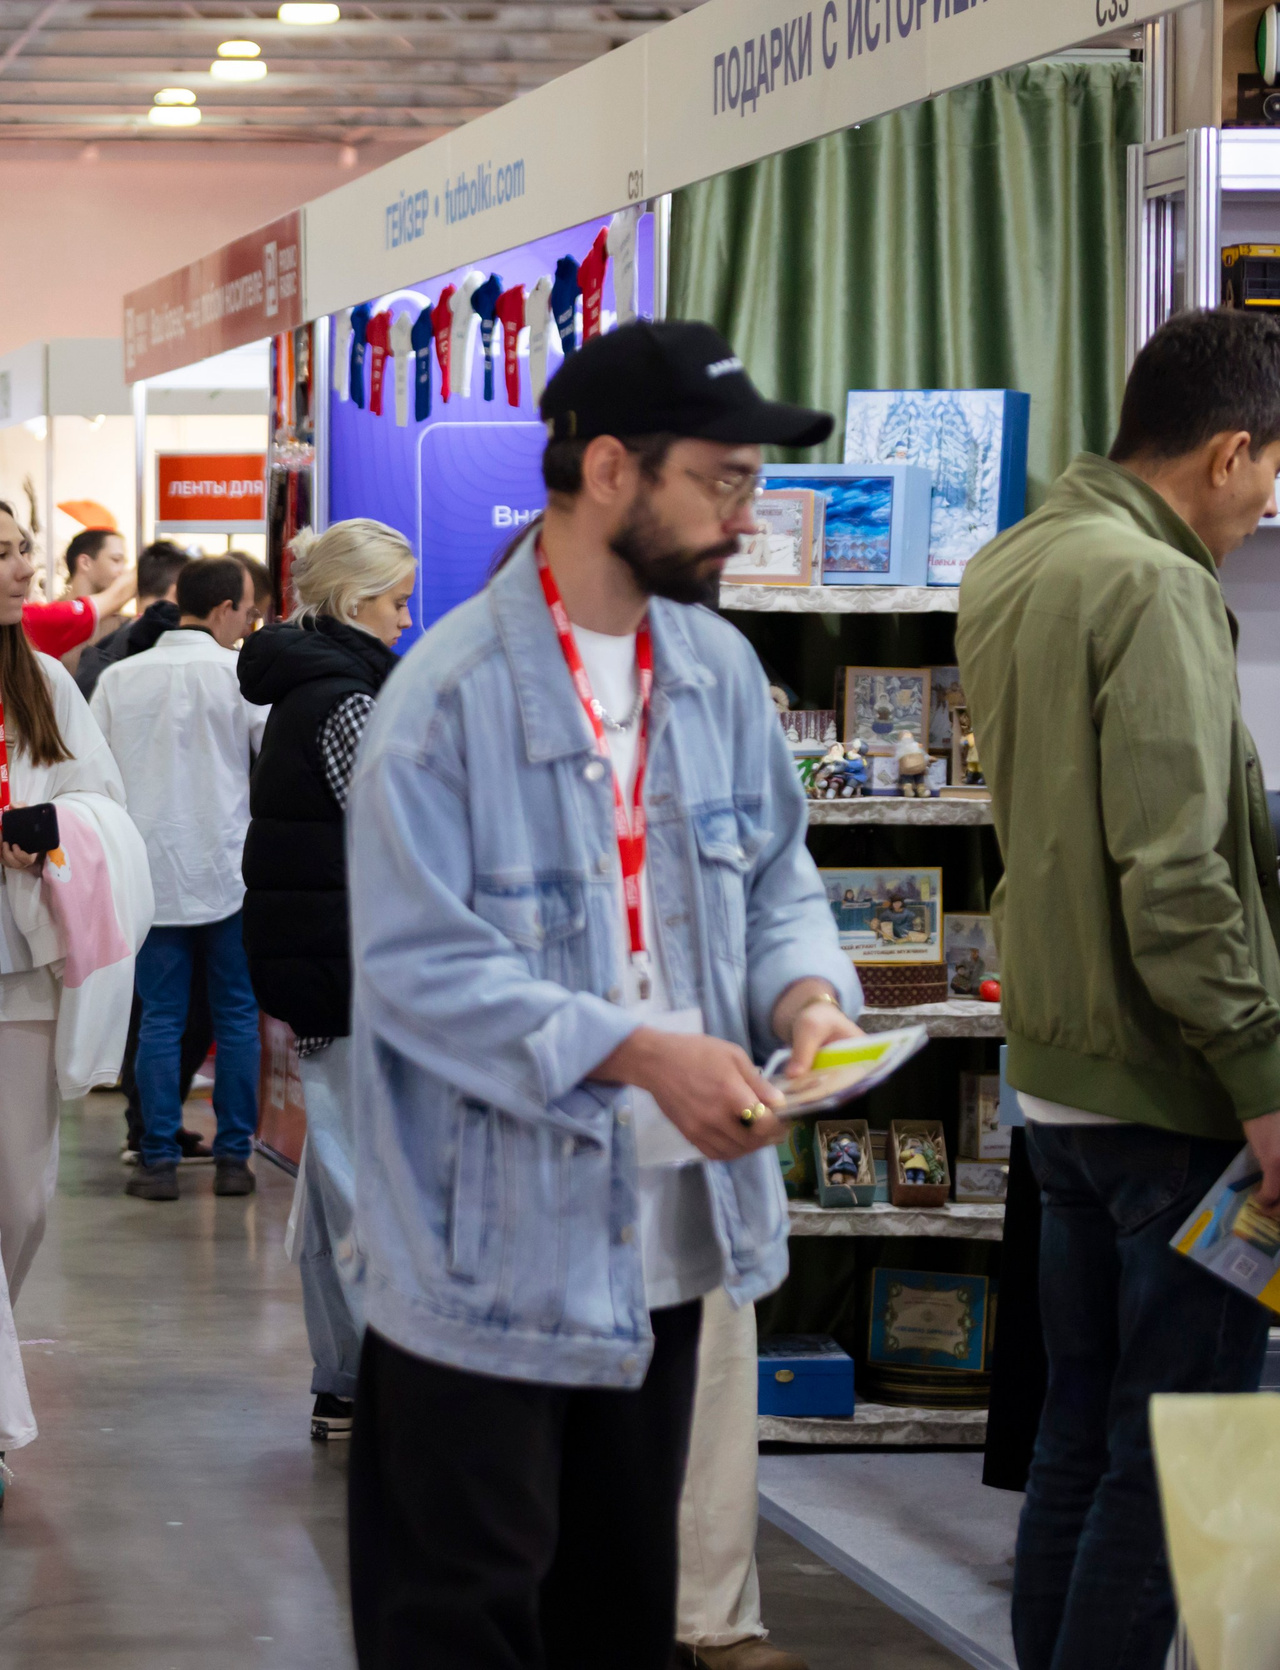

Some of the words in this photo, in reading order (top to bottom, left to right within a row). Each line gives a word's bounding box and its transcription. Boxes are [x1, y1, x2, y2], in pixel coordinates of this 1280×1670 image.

[714, 12, 812, 117] ПОДАРКИ
[823, 1, 838, 69] С
[847, 0, 987, 60] ИСТО
[385, 189, 429, 250] ГЕЙЗЕР
[445, 157, 525, 225] futbolki.com
[628, 169, 644, 200] C31
[169, 480, 226, 498] ЛЕНТЫ
[229, 479, 265, 498] ДЛЯ
